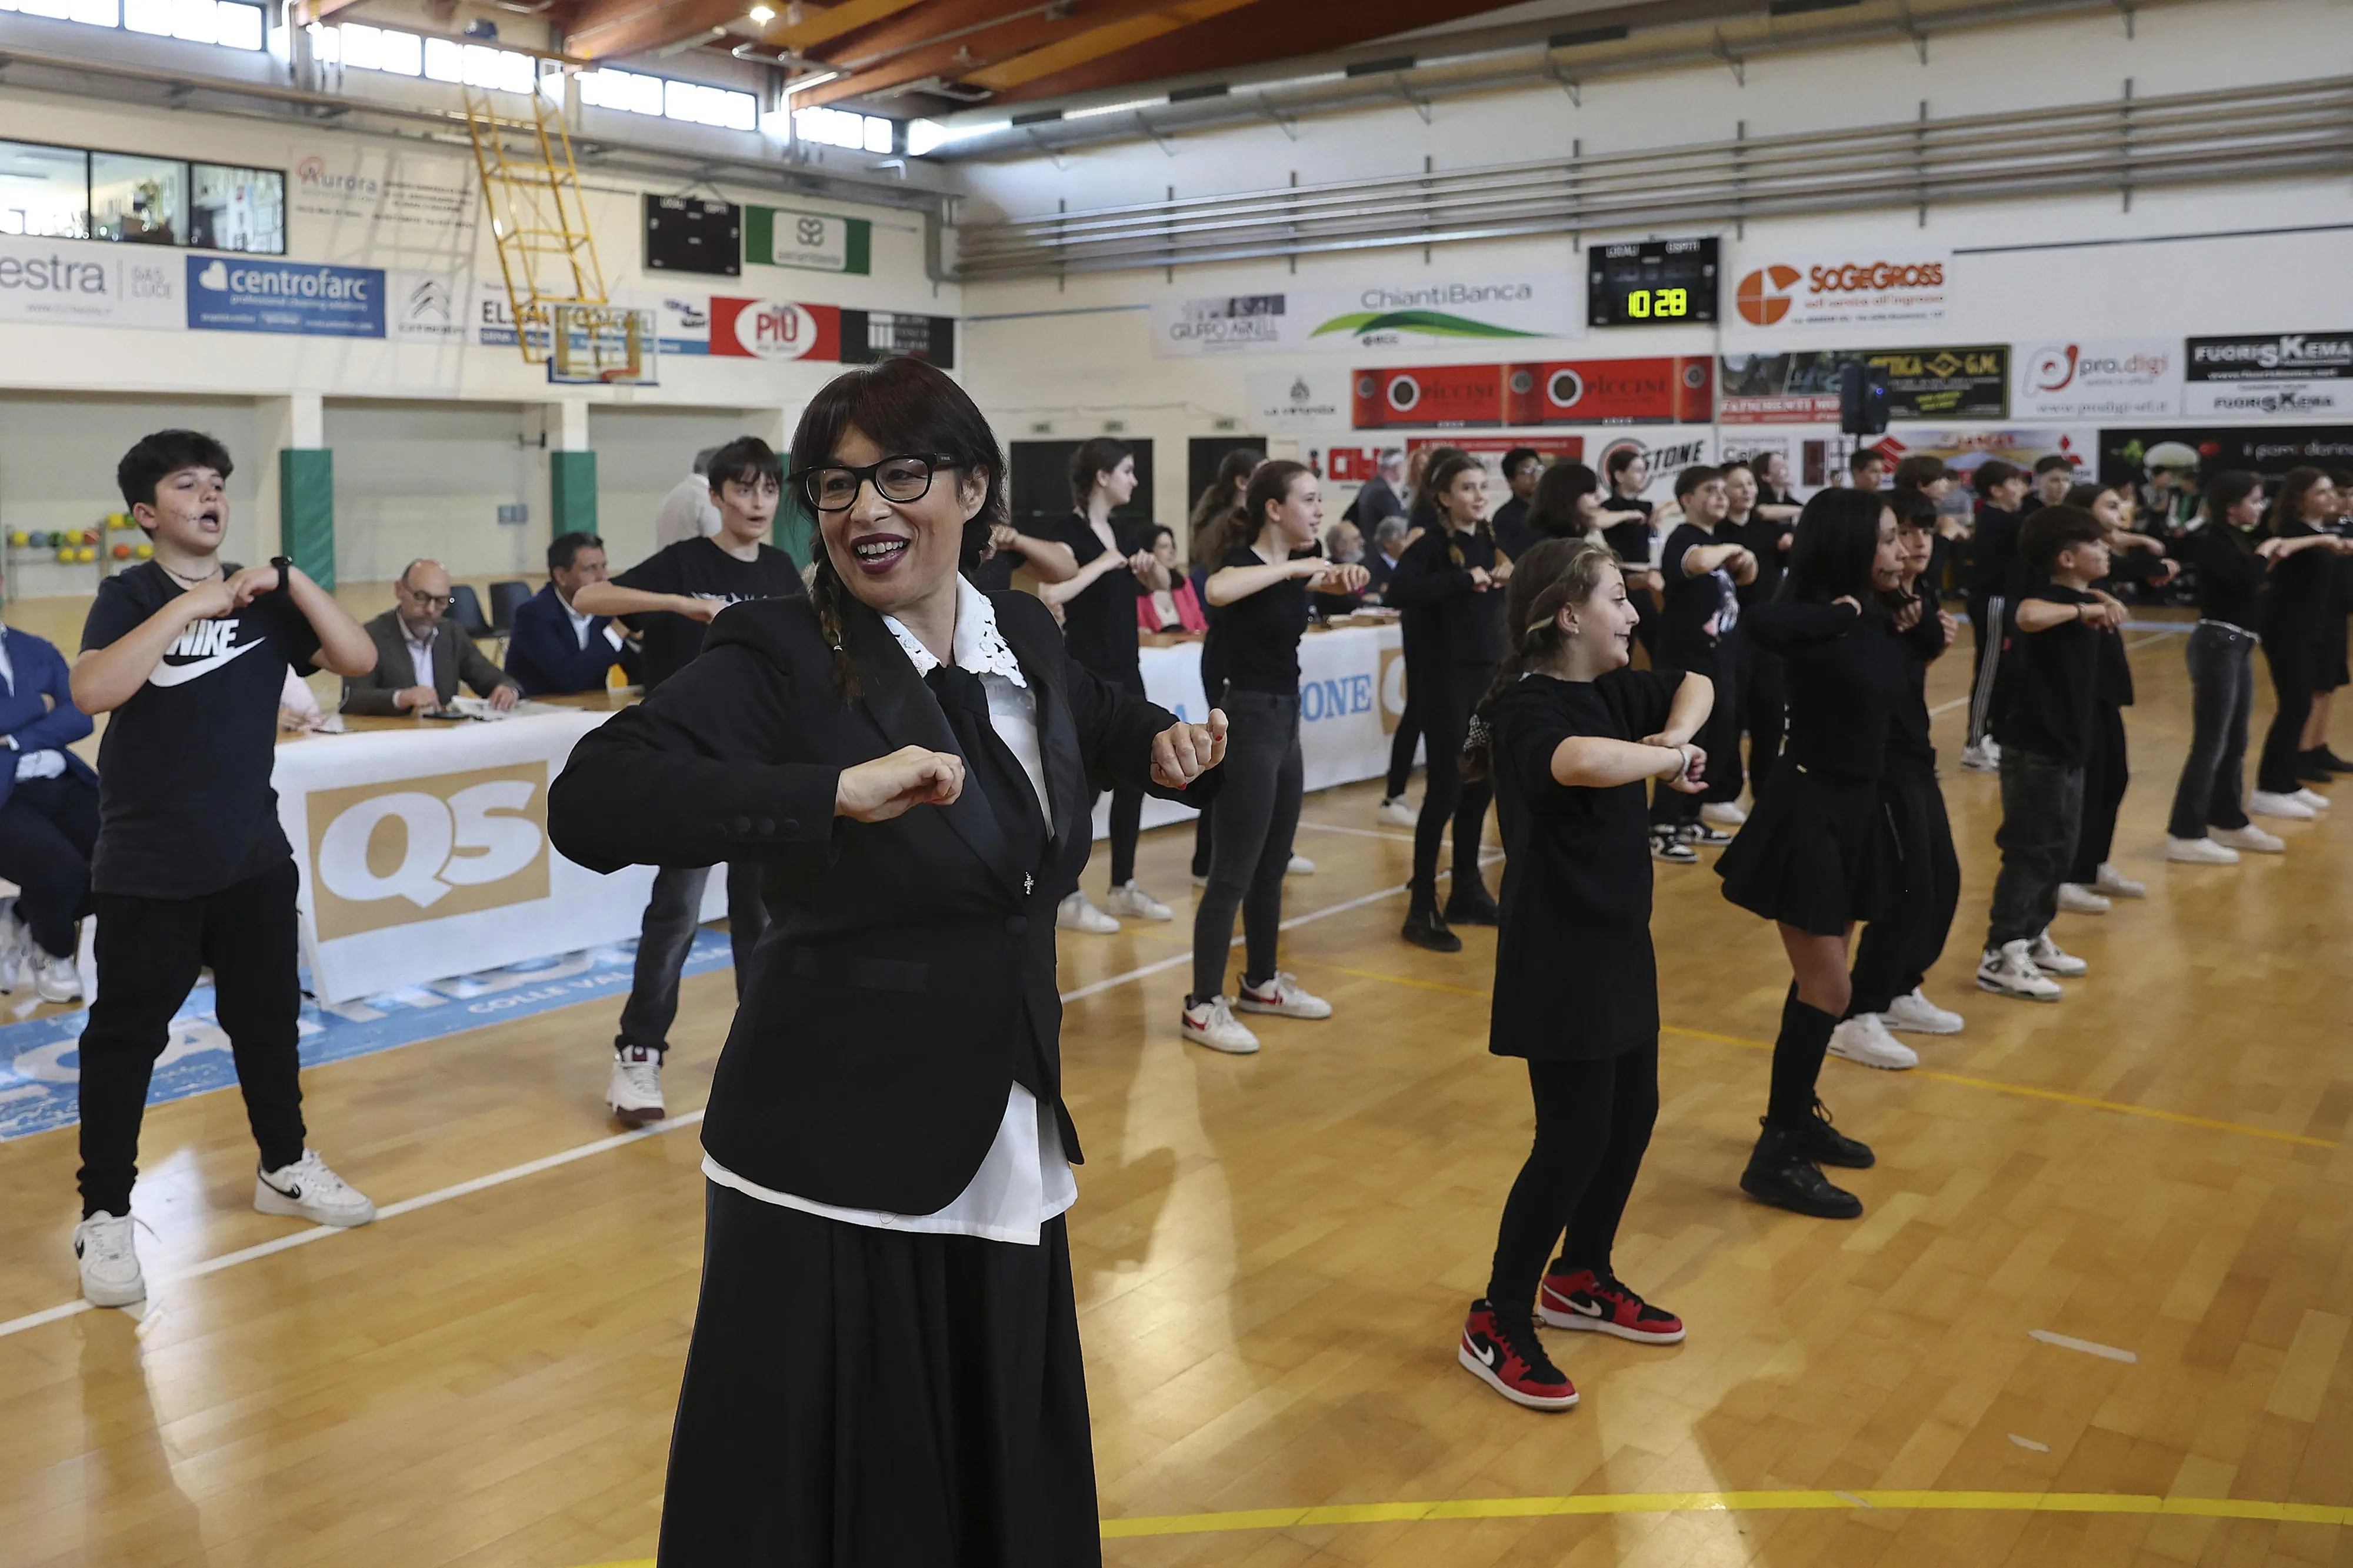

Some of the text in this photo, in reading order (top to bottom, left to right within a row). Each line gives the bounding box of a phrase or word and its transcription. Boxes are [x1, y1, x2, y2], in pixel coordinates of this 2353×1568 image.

[230, 268, 368, 301] centrofarc
[1360, 283, 1533, 309] ChiantiBanca
[1628, 288, 1687, 318] 10 28
[164, 619, 240, 656] NIKE
[318, 779, 543, 909] QS
